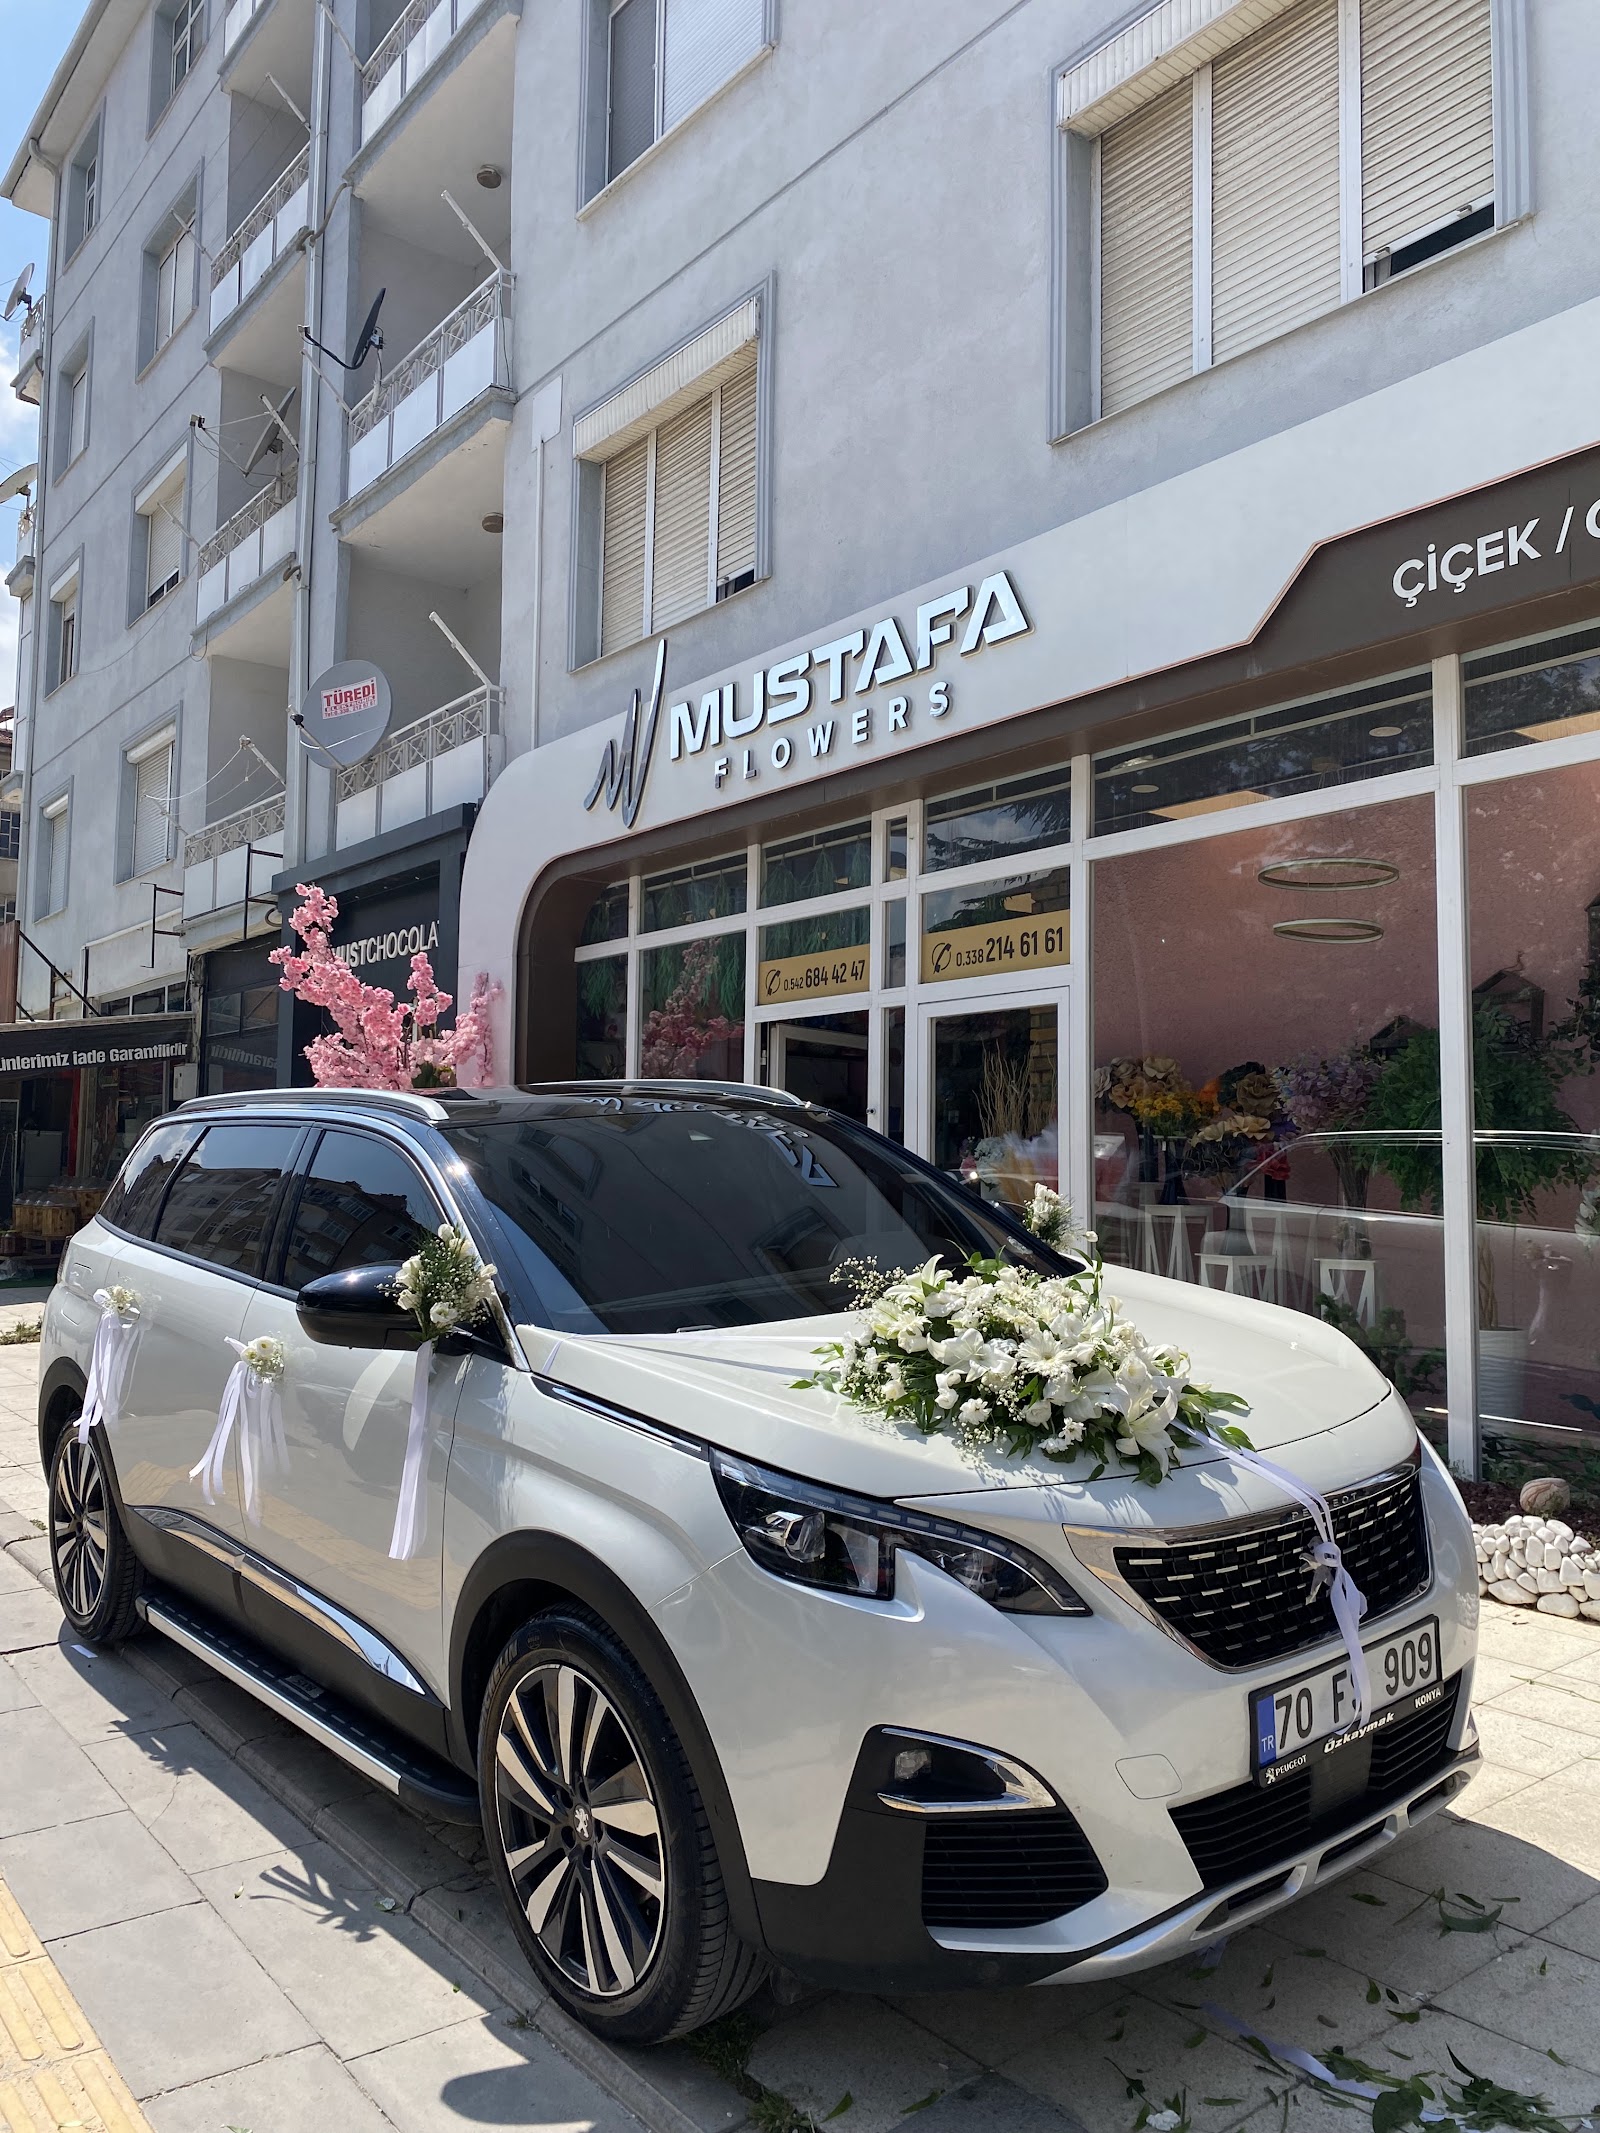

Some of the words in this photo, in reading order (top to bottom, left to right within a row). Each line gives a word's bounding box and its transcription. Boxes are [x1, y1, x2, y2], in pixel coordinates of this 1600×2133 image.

[1392, 516, 1542, 608] ÇİÇEK
[670, 569, 1033, 761] MUSTAFA
[323, 679, 376, 707] TÜREDİ
[714, 680, 951, 789] FLOWERS
[332, 920, 439, 968] MUSTCHOCOLA
[956, 949, 984, 967] 0.338
[986, 935, 1015, 963] 214
[1020, 931, 1038, 958] 61
[1045, 927, 1063, 953] 61
[805, 966, 829, 988] 684
[832, 962, 847, 984] 42
[850, 960, 866, 981] 47
[1291, 1492, 1358, 1521] PEEOT
[1275, 1687, 1313, 1750] 70
[1384, 1632, 1433, 1696] 909
[1261, 1734, 1275, 1753] TR
[1275, 1754, 1308, 1777] PEUGEOT
[1323, 1712, 1396, 1754] Özkaymak
[1414, 1687, 1442, 1709] KONYA
